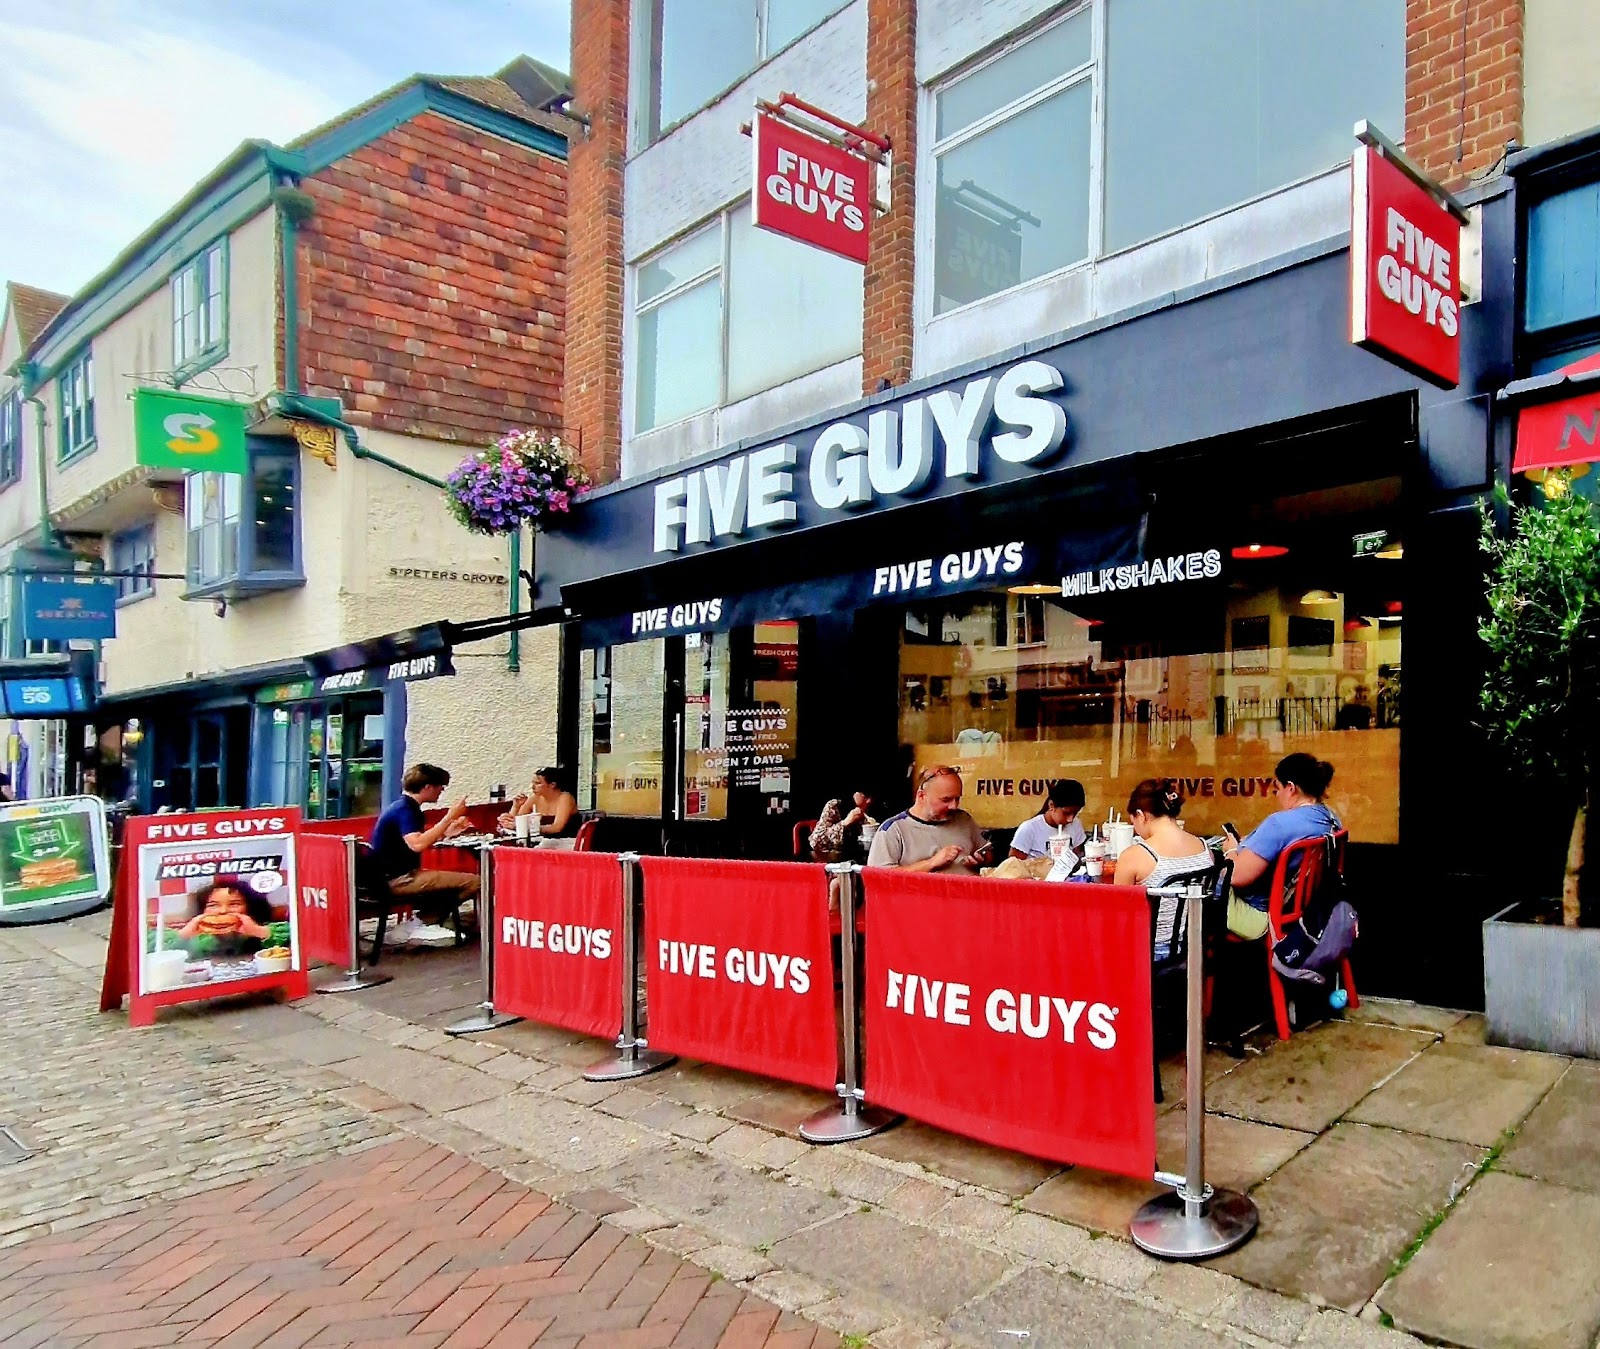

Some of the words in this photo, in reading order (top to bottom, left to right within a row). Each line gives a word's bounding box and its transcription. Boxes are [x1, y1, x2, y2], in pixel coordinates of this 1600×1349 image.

[777, 147, 855, 202] FIVE
[766, 174, 865, 232] GUYS
[1386, 206, 1451, 290] FIVE
[1378, 254, 1458, 337] GUYS
[653, 442, 797, 552] FIVE
[809, 360, 1068, 510] GUYS
[872, 557, 933, 596] FIVE
[939, 541, 1024, 583] GUYS
[1061, 549, 1222, 597] MILKSHAKES
[631, 606, 667, 635] FIVE
[671, 598, 723, 628] GUYS
[388, 661, 408, 680] FIVE
[409, 655, 436, 676] GUYS
[742, 718, 788, 732] GUYS
[705, 757, 739, 768] OPEN
[742, 757, 750, 766] 7
[753, 754, 784, 766] DAYS
[976, 778, 1013, 796] FIVE
[1018, 778, 1056, 796] GUY
[147, 823, 208, 839] FIVE
[214, 817, 286, 834] GUYS
[161, 861, 217, 878] KIDS
[219, 858, 279, 874] MEAL
[163, 853, 193, 864] FIVE
[302, 886, 328, 909] UYS
[502, 915, 545, 949] FIVE
[548, 923, 612, 960] GUYS
[659, 938, 716, 979] FIVE
[725, 947, 812, 994] GUYS
[885, 968, 971, 1026] FIVE
[985, 988, 1118, 1050] GUYS
